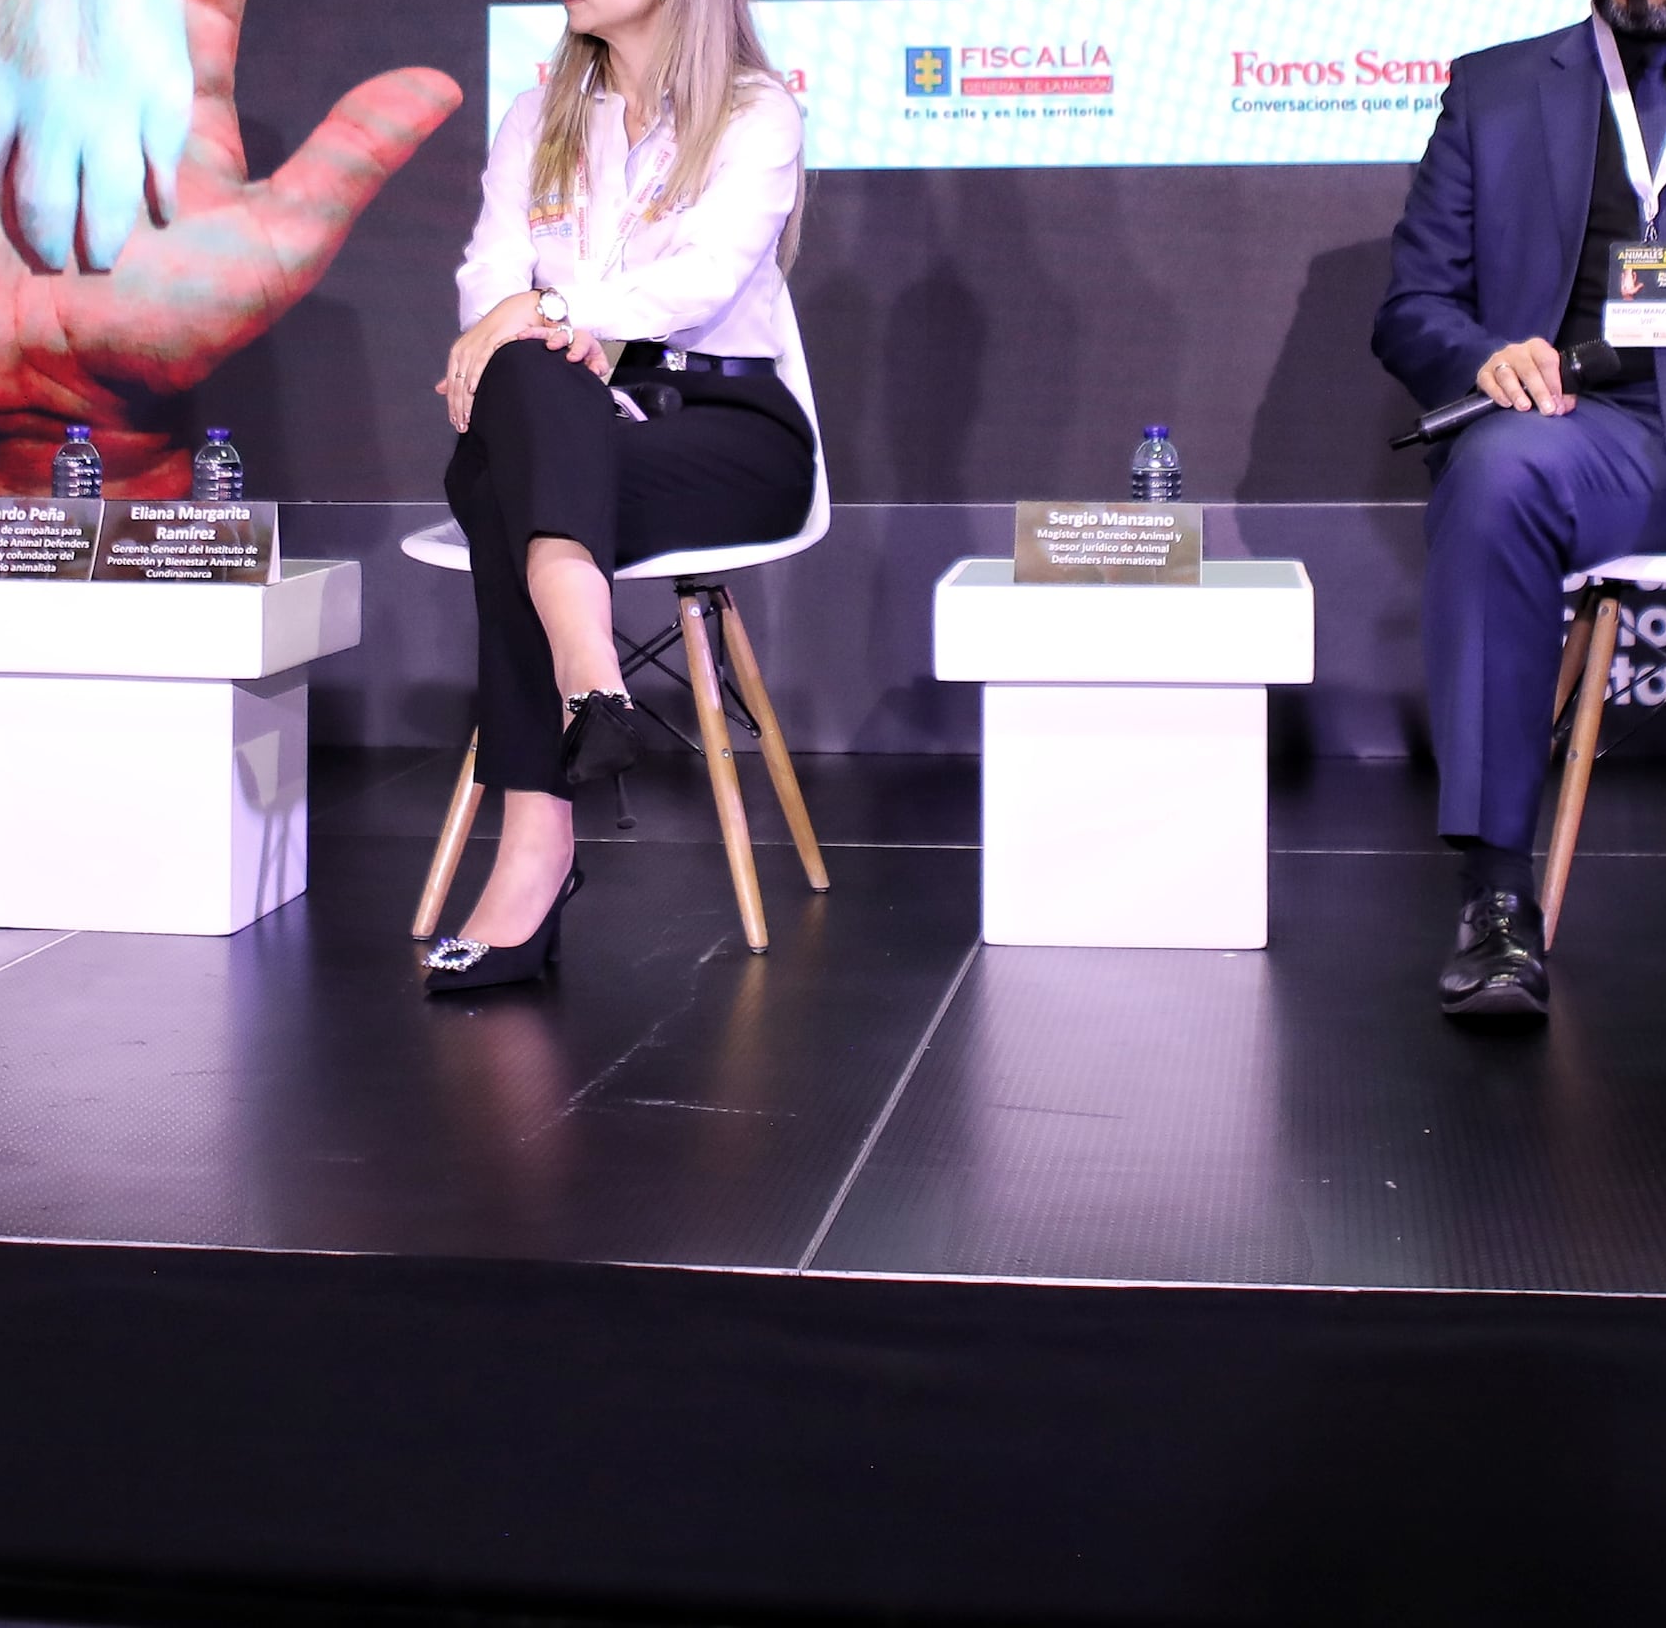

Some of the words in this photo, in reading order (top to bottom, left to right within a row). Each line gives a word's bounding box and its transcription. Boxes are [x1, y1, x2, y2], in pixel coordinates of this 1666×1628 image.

[960, 40, 1111, 69] FISCALÍA
[1231, 51, 1345, 87] Foros
[1232, 97, 1357, 112] Conversaciones
[1362, 99, 1391, 111] que
[1396, 95, 1408, 109] el
[30, 508, 65, 521] Peña
[131, 507, 174, 519] Eliana
[179, 507, 250, 522] Margarita
[1049, 512, 1098, 527] Sergio
[1102, 512, 1174, 526] Manzano
[1, 525, 13, 534] de
[14, 526, 60, 536] campañas
[61, 527, 82, 537] para
[156, 527, 216, 540] Ramírez
[1083, 531, 1094, 539] en
[1097, 530, 1137, 540] Derecho
[1140, 531, 1172, 541] Animal
[1174, 533, 1182, 542] y
[10, 538, 42, 547] Animal
[44, 539, 90, 548] Defenders
[112, 545, 149, 553] Gerente
[150, 544, 187, 553] General
[188, 545, 203, 553] del
[205, 545, 244, 554] Instituto
[245, 545, 258, 554] de
[1082, 542, 1118, 553] jurídico
[1121, 544, 1133, 552] de
[1136, 544, 1170, 553] Animal
[6, 551, 58, 560] cofundador
[60, 552, 74, 560] del
[1052, 555, 1101, 564] Defenders
[1103, 555, 1166, 565] International
[10, 564, 56, 572] animalista
[107, 557, 155, 565] Protección
[165, 557, 208, 566] Bienestar
[210, 557, 242, 566] Animal
[244, 558, 256, 567] de
[146, 570, 212, 578] Cundinamarca
